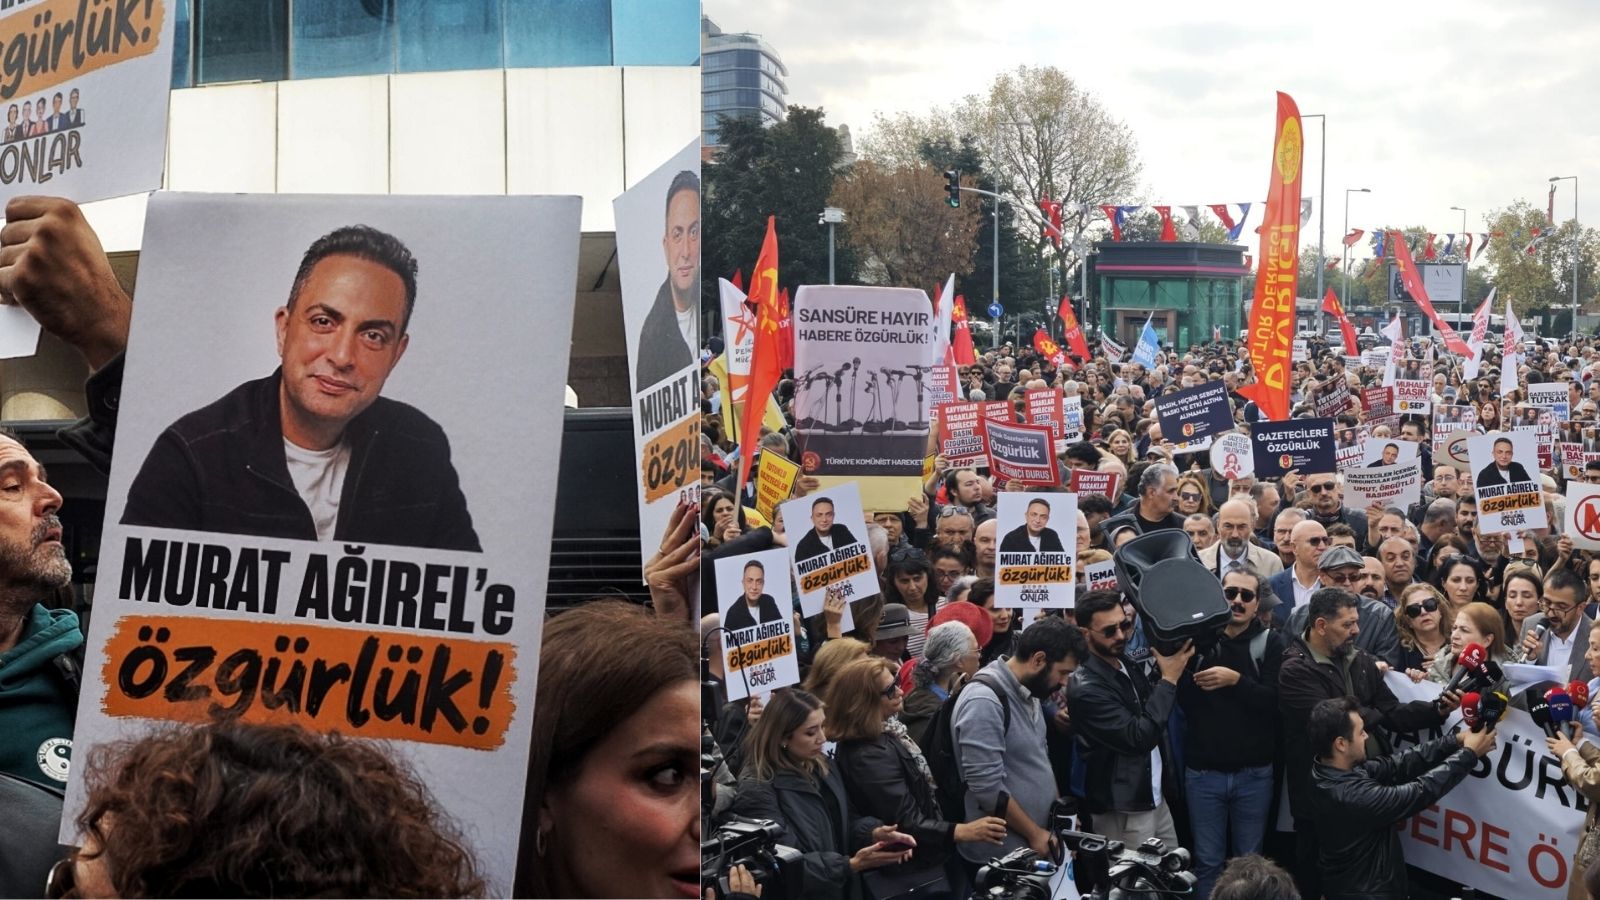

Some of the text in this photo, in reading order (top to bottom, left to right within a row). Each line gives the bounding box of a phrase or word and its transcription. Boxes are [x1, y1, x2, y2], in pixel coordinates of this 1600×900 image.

[0, 0, 154, 98] gürlük!
[1, 131, 82, 185] ONLAR
[799, 307, 878, 325] SANSÜRE
[881, 312, 929, 327] HAYIR
[799, 329, 929, 344] HABERE ÖZGÜRLÜK!
[1399, 387, 1427, 396] BASIN
[1531, 396, 1568, 404] TUTSAK
[640, 370, 700, 436] MURAT A
[1409, 402, 1425, 410] SEP
[953, 429, 972, 437] BASIN
[1257, 428, 1329, 442] GAZETECİLERE
[991, 436, 1040, 459] Özgürlük
[1267, 440, 1321, 453] ÖZGÜRLÜK
[826, 456, 855, 465] TÜRKİYE
[855, 457, 891, 466] KOMÜNİST
[953, 459, 974, 467] EHP
[1478, 481, 1538, 499] MURAT AĞIREL'e
[1482, 494, 1540, 512] özgürlük!
[1500, 516, 1526, 526] ONLAR
[798, 543, 867, 576] MURAT AĞIREL'e
[1000, 551, 1071, 565] MURAT AĞIREL'e
[803, 554, 869, 590] özgürlük!
[1002, 567, 1071, 584] özgürlük!
[1089, 569, 1116, 581] İSMA
[119, 537, 516, 635] MURAT AĞIREL'e
[1020, 593, 1050, 602] ONLAR
[725, 622, 790, 649] MURAT AĞIREL'e
[730, 636, 791, 669] özgürlük!
[118, 625, 505, 735] özgürlük!
[750, 672, 777, 687] ONLAR
[1396, 803, 1569, 890] ERE Ö
